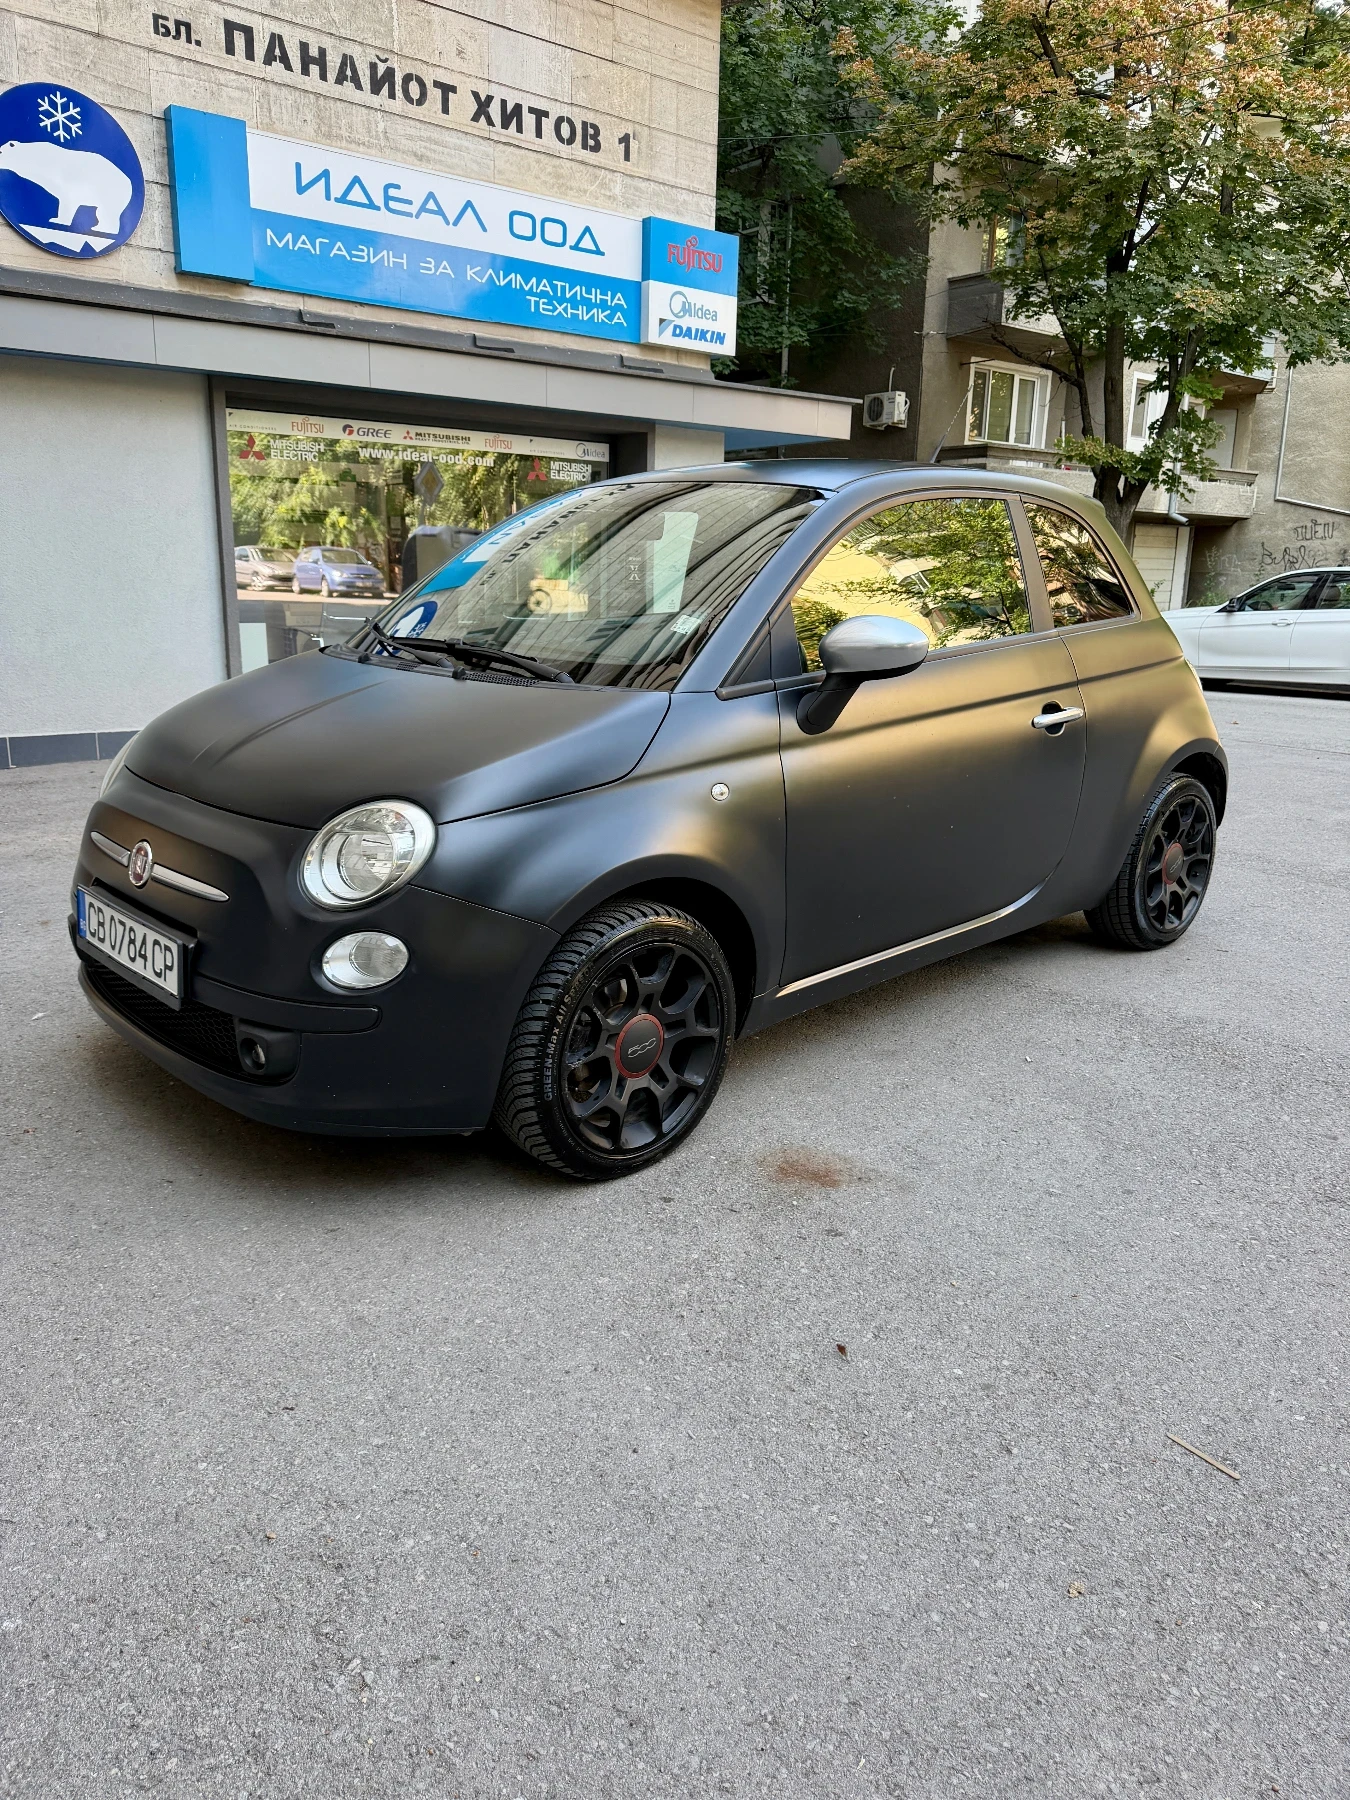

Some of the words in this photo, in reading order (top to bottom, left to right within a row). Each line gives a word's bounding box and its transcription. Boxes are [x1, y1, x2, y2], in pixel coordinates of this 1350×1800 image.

[223, 18, 457, 116] ПАНАЙОТ
[470, 89, 602, 154] ХИТОВ
[617, 132, 633, 162] 1
[295, 161, 487, 233] ИДЕАЛ
[508, 210, 605, 257] ООД
[667, 236, 723, 273] FUJITSU
[266, 228, 408, 271] МАГАЗИН
[420, 257, 454, 279] ЗА
[466, 264, 627, 309] КЛИМАТИЧНА
[525, 295, 627, 328] ТЕХНИКА
[672, 324, 726, 345] DAIKIN
[291, 416, 325, 435] FUJITSU
[356, 427, 393, 439] GREE
[270, 440, 325, 452] MITSUBISHI
[415, 431, 471, 442] MITSUBISHI
[484, 433, 513, 451] FUJITSU
[271, 452, 319, 462] ELECTRIC
[359, 447, 495, 467] www.ideal-ood.com
[576, 443, 605, 458] Midea
[550, 461, 592, 473] MITSUBISHI
[550, 470, 587, 482] ELECTRIC
[109, 915, 148, 970] 0784
[152, 938, 175, 982] CP
